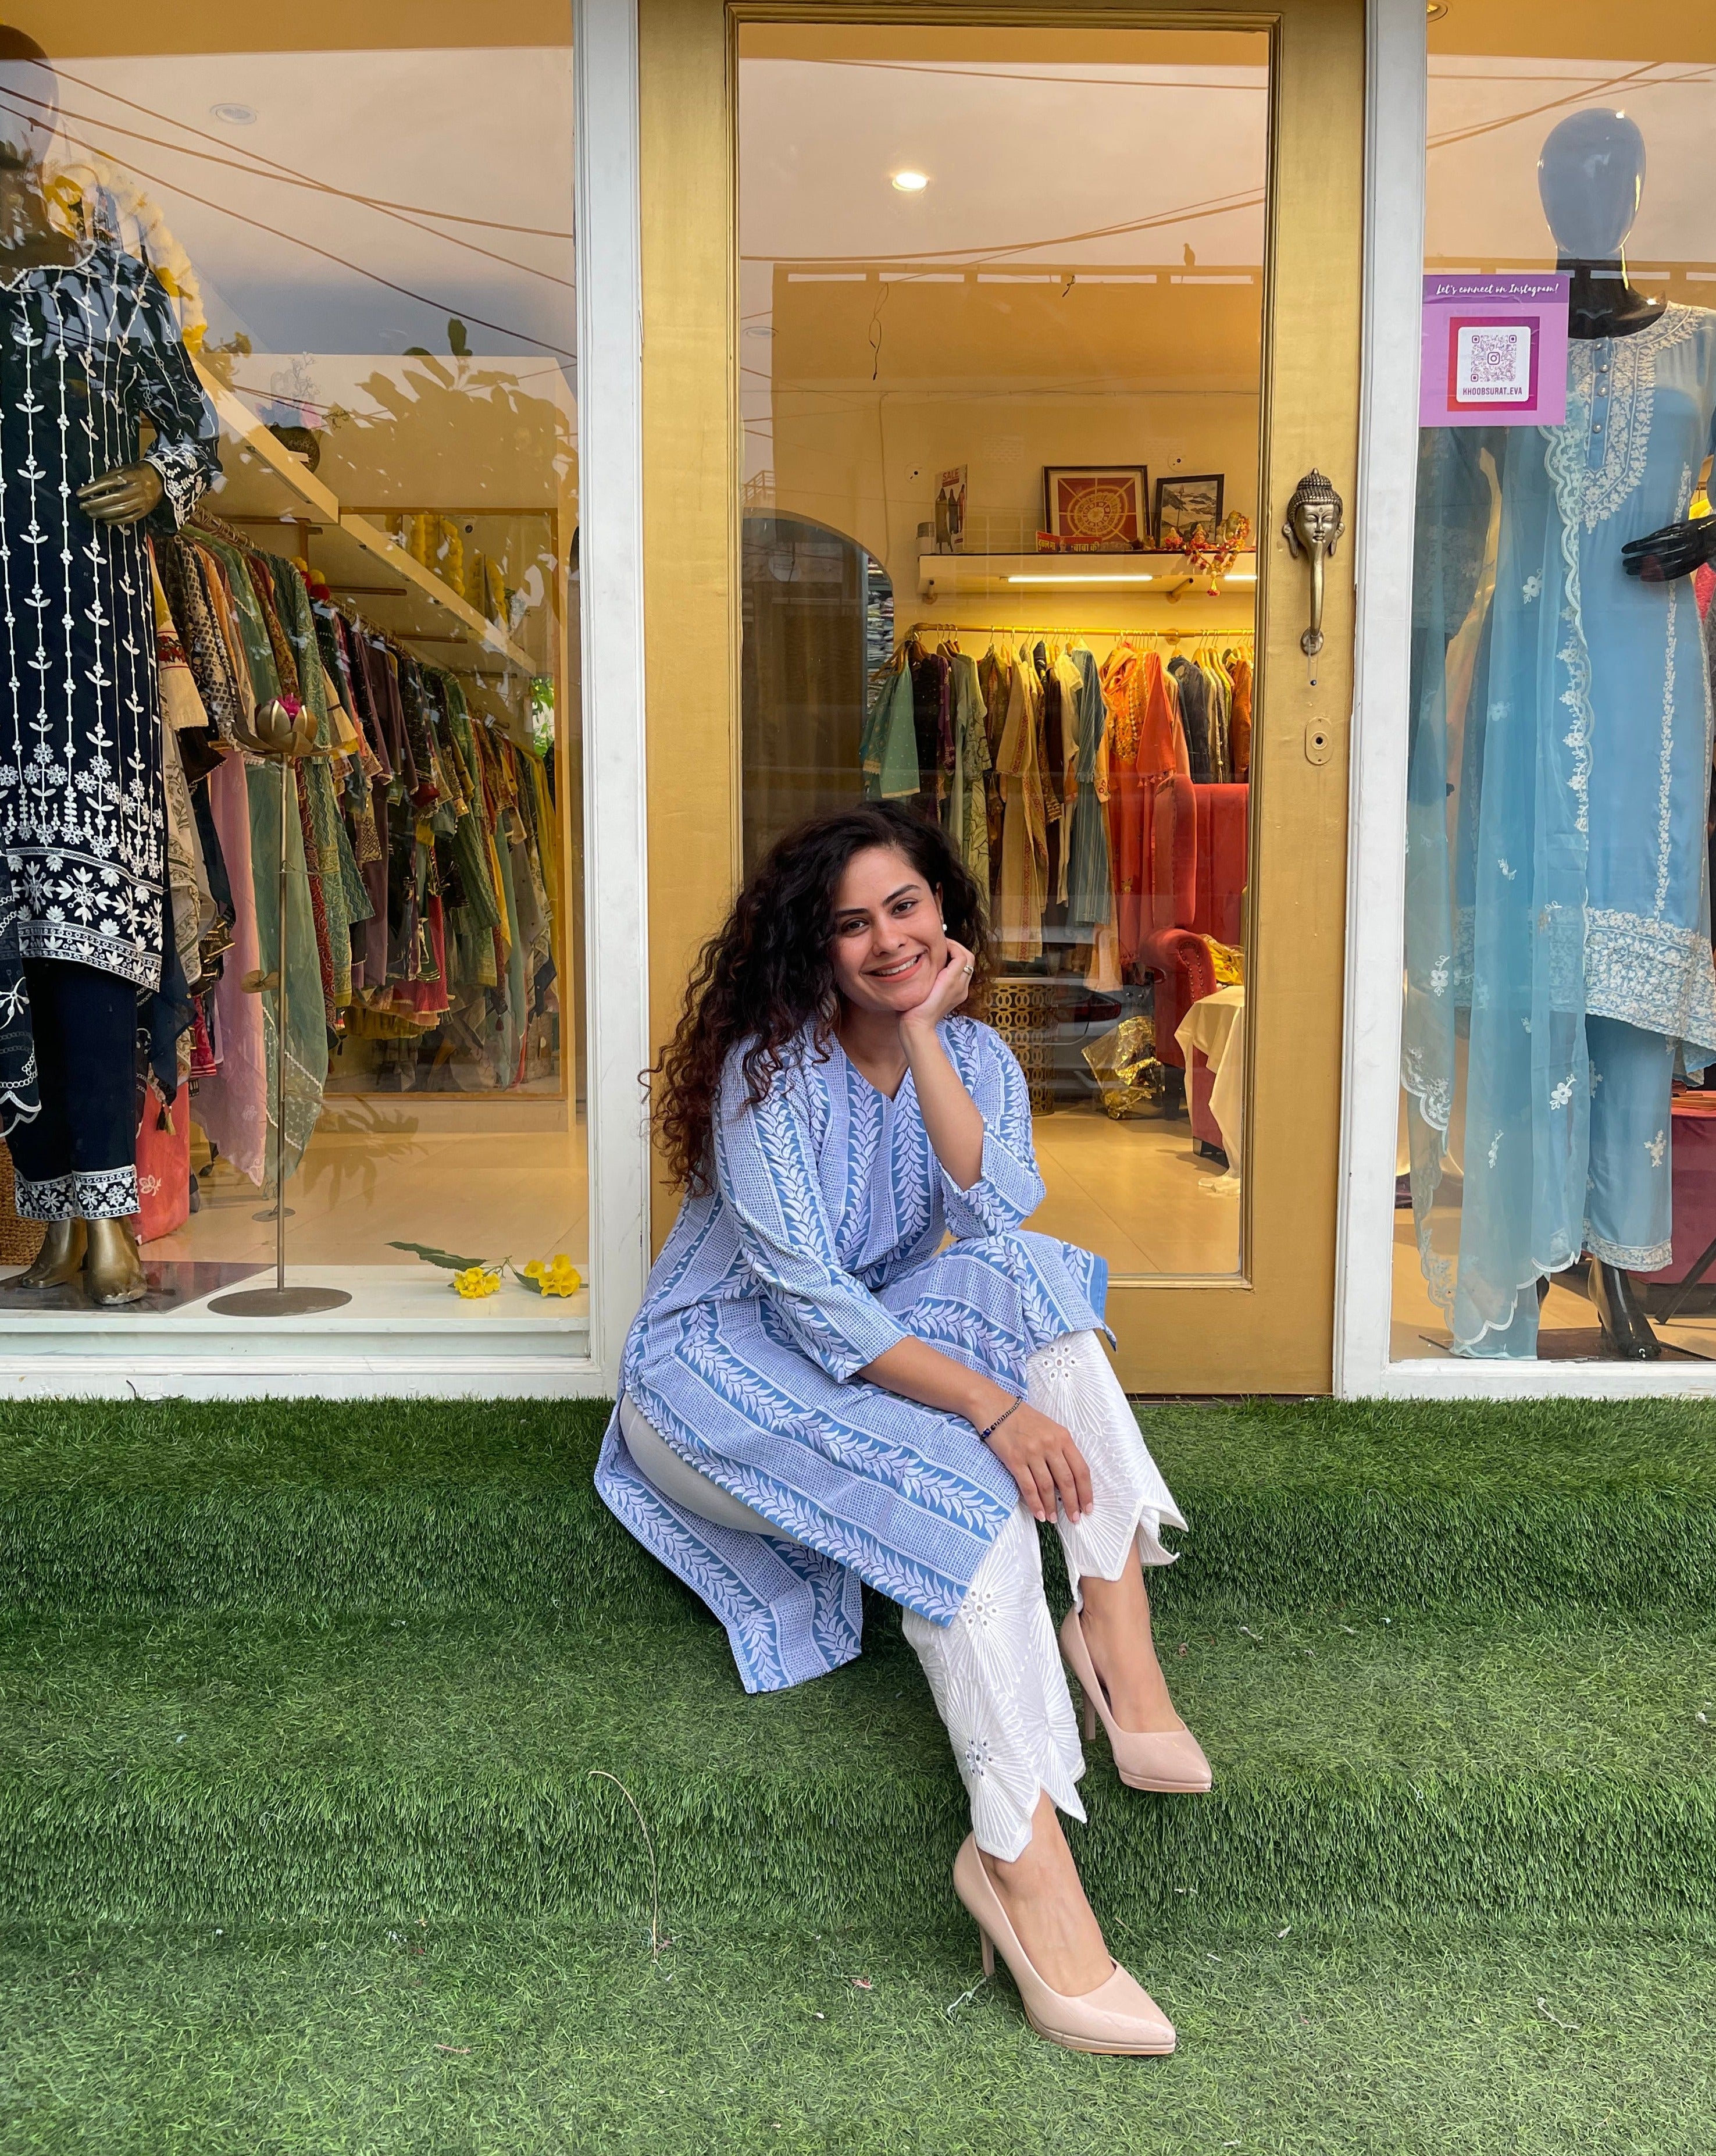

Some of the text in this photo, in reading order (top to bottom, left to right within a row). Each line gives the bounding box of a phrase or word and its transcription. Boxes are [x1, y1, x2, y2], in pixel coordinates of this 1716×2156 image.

[1436, 283, 1559, 297] Let's connect on Instagram!
[1462, 387, 1522, 395] KHOOBSURAT_EVA
[943, 468, 959, 482] SALE
